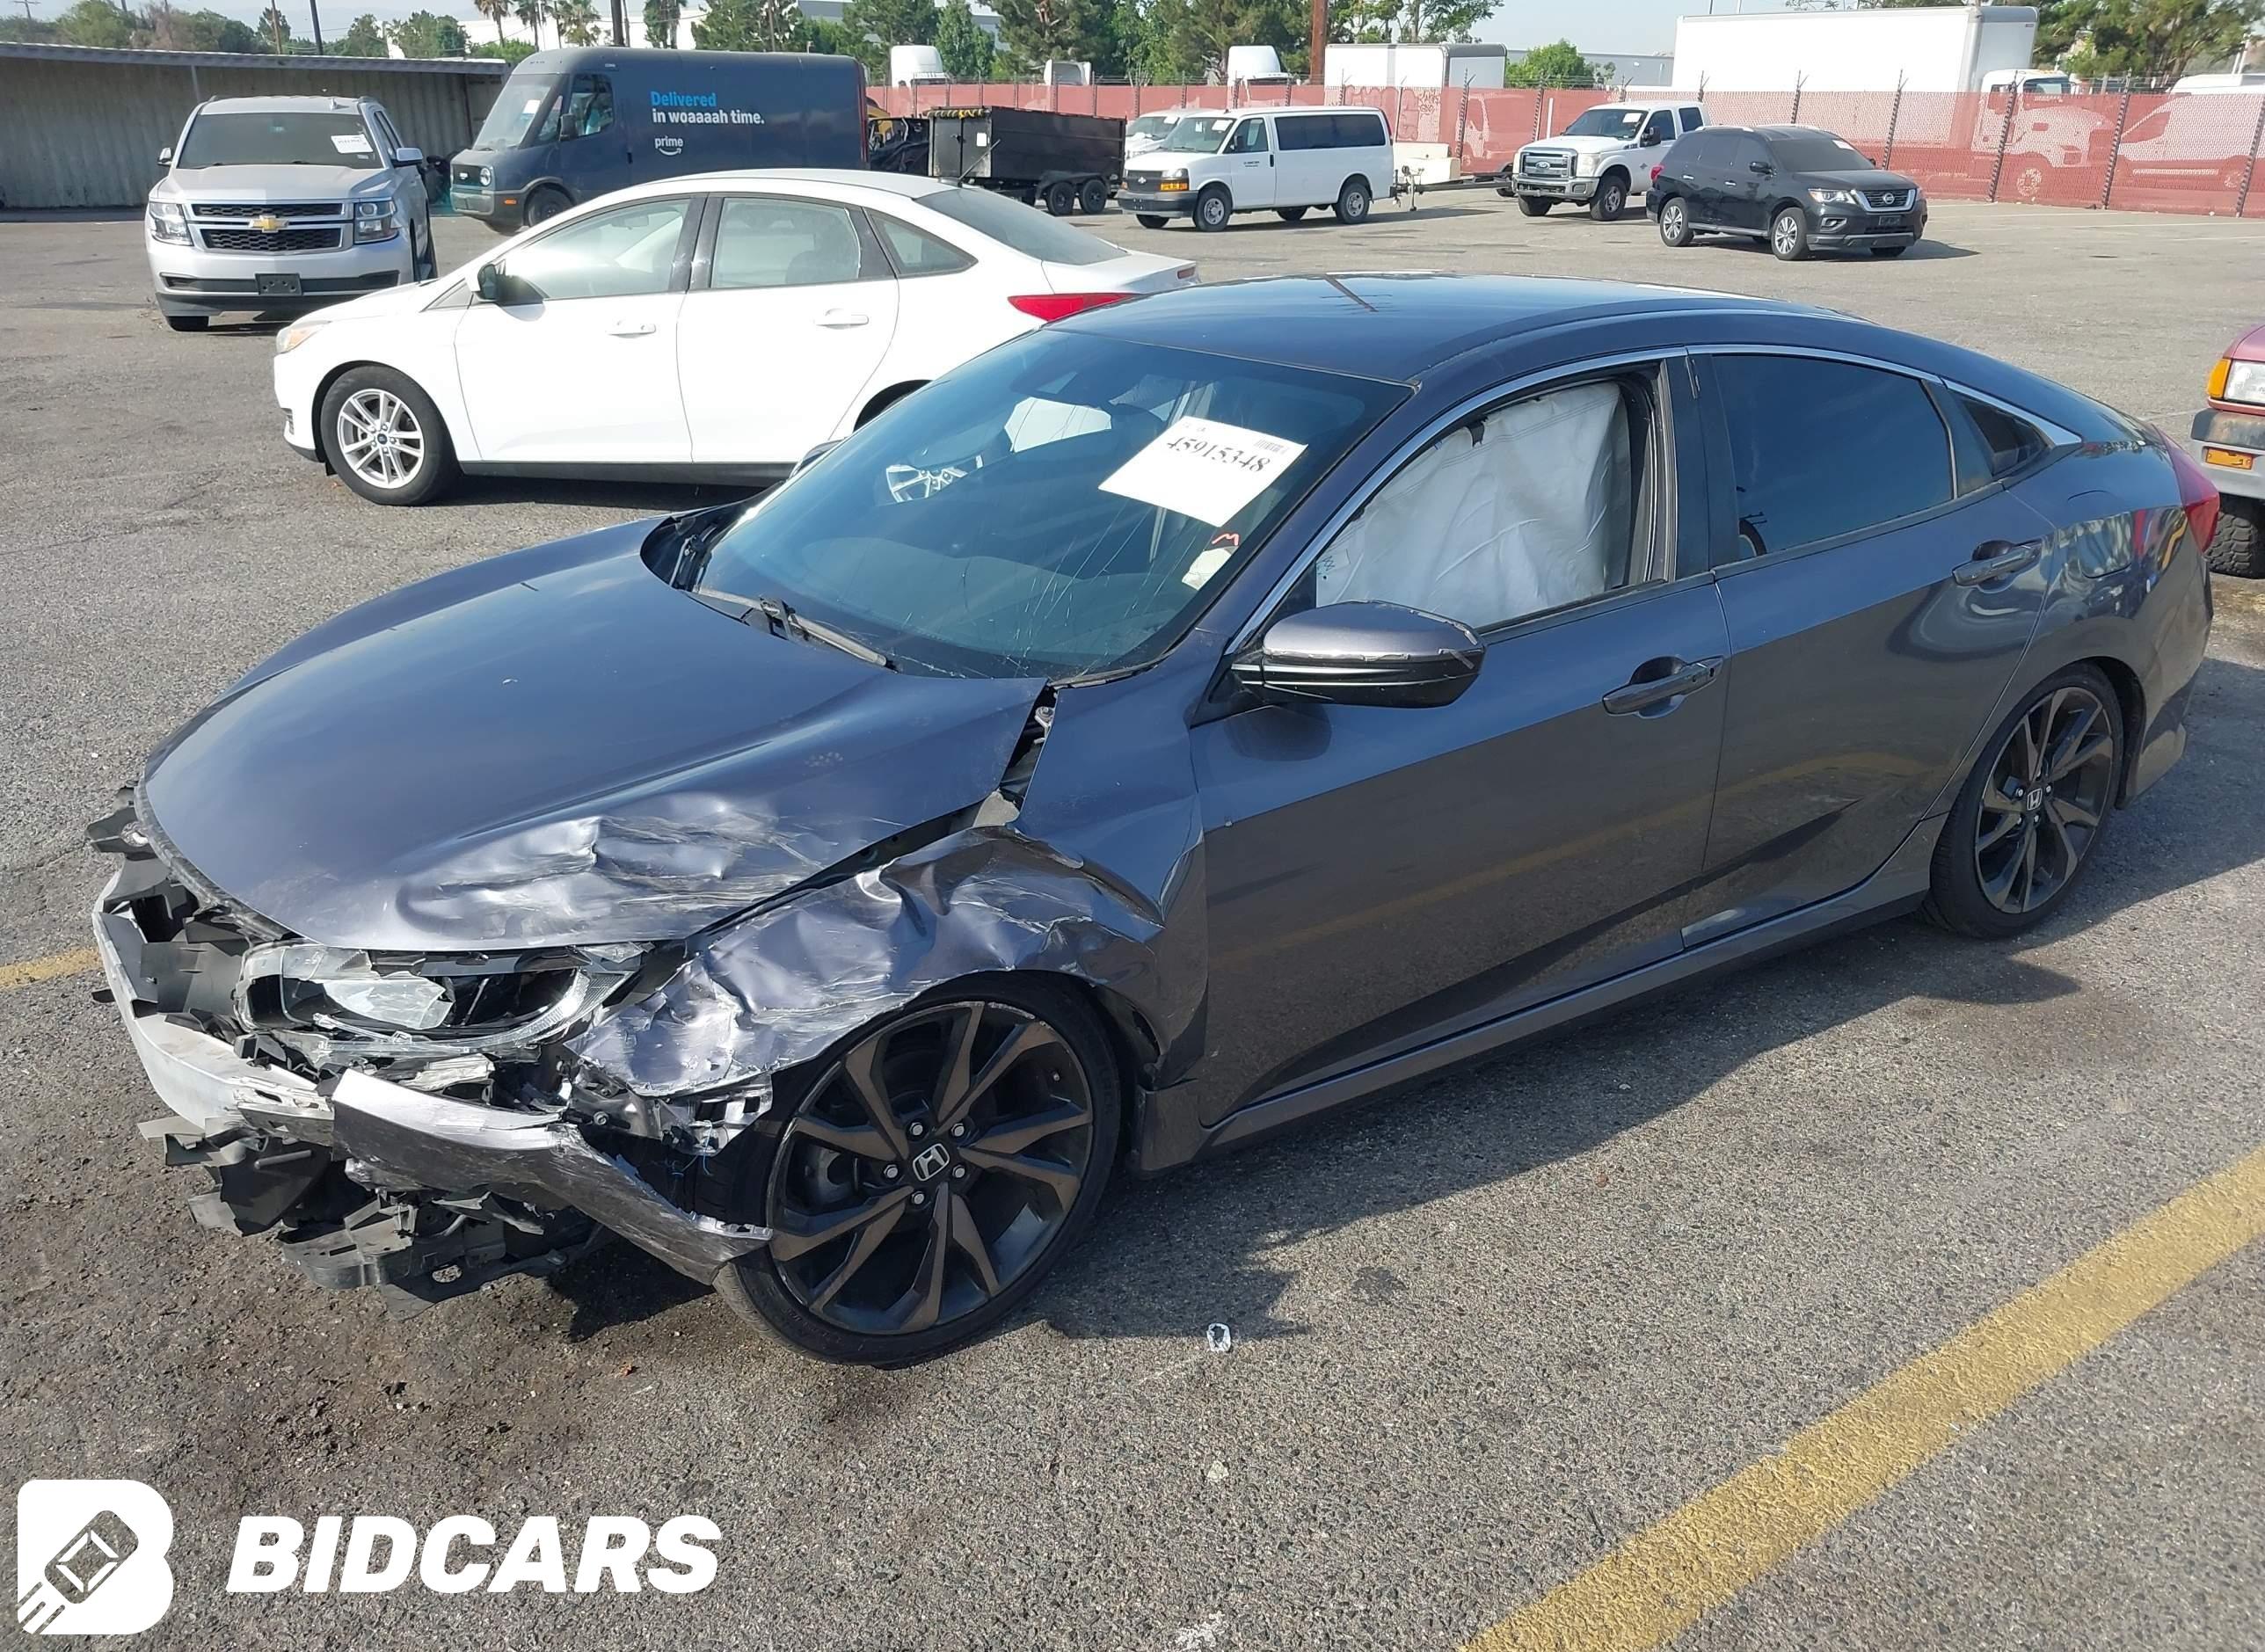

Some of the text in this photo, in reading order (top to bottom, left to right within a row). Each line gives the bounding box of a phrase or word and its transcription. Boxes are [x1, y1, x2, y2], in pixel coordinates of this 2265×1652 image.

[651, 91, 717, 106] Delivered
[652, 108, 765, 124] in woaaaah time.
[654, 135, 684, 149] prime
[1167, 437, 1271, 472] 45915348
